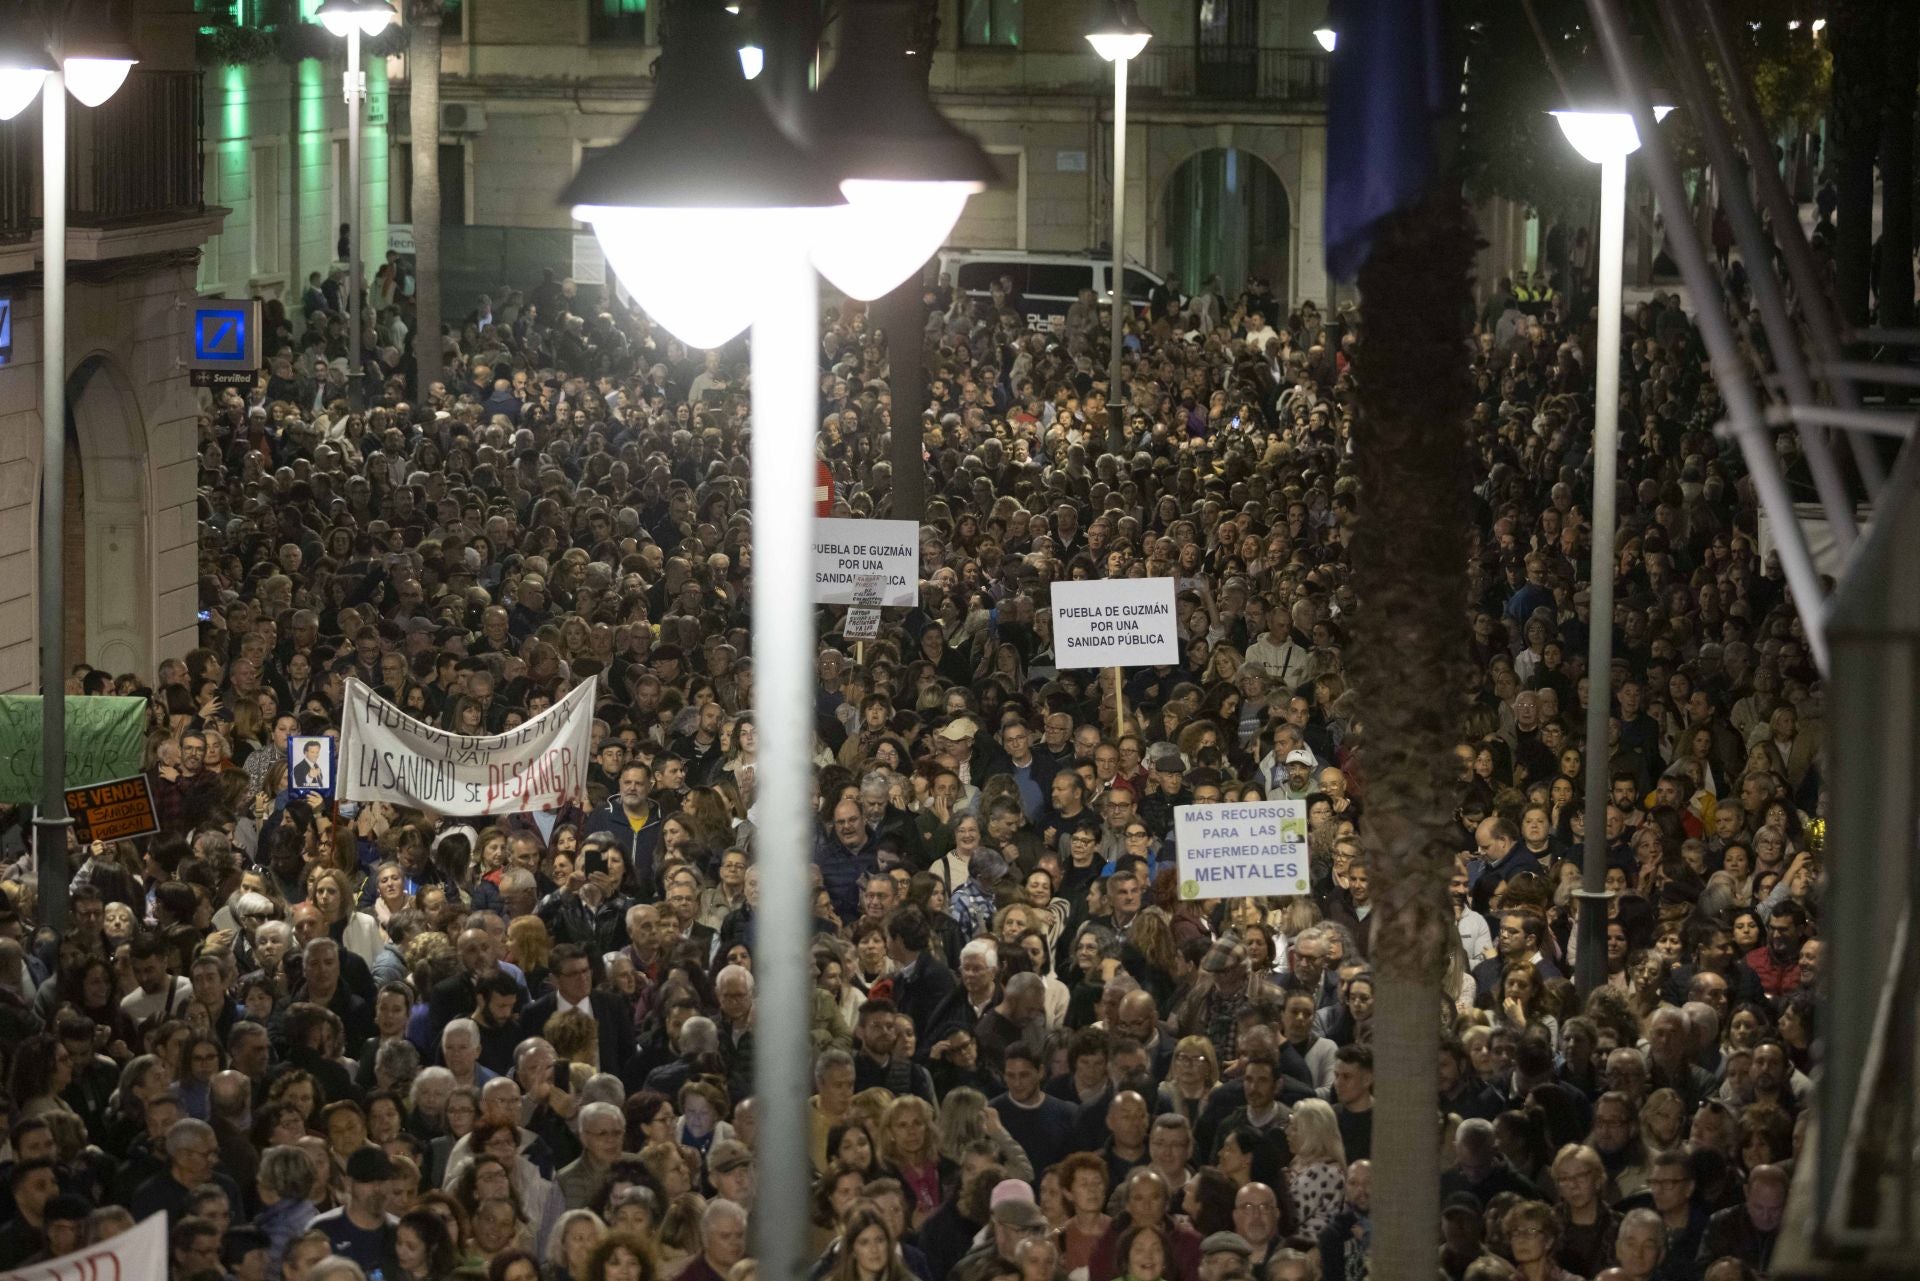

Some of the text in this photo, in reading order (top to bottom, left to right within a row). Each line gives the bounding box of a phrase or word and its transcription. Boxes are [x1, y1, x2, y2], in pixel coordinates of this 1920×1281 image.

[213, 373, 251, 383] ServiRed
[811, 544, 912, 557] PUEBLA DE GUZMÁN
[838, 559, 884, 571] POR UNA
[815, 572, 855, 584] SANIDA
[1059, 602, 1168, 618] PUEBLA DE GUZMÁN
[1091, 620, 1139, 632] POR UNA
[1067, 633, 1165, 648] SANIDAD PÚBLICA
[10, 748, 119, 779] CUDAR
[359, 744, 379, 788] LA
[382, 751, 456, 802] SANIDAD
[464, 782, 482, 803] SE
[67, 779, 147, 811] SE VENDE
[1221, 807, 1295, 820] RECURSOS
[1202, 825, 1277, 839] PARA LAS
[1187, 843, 1297, 860] ENFERMEDADES
[1195, 863, 1298, 882] MENTALES
